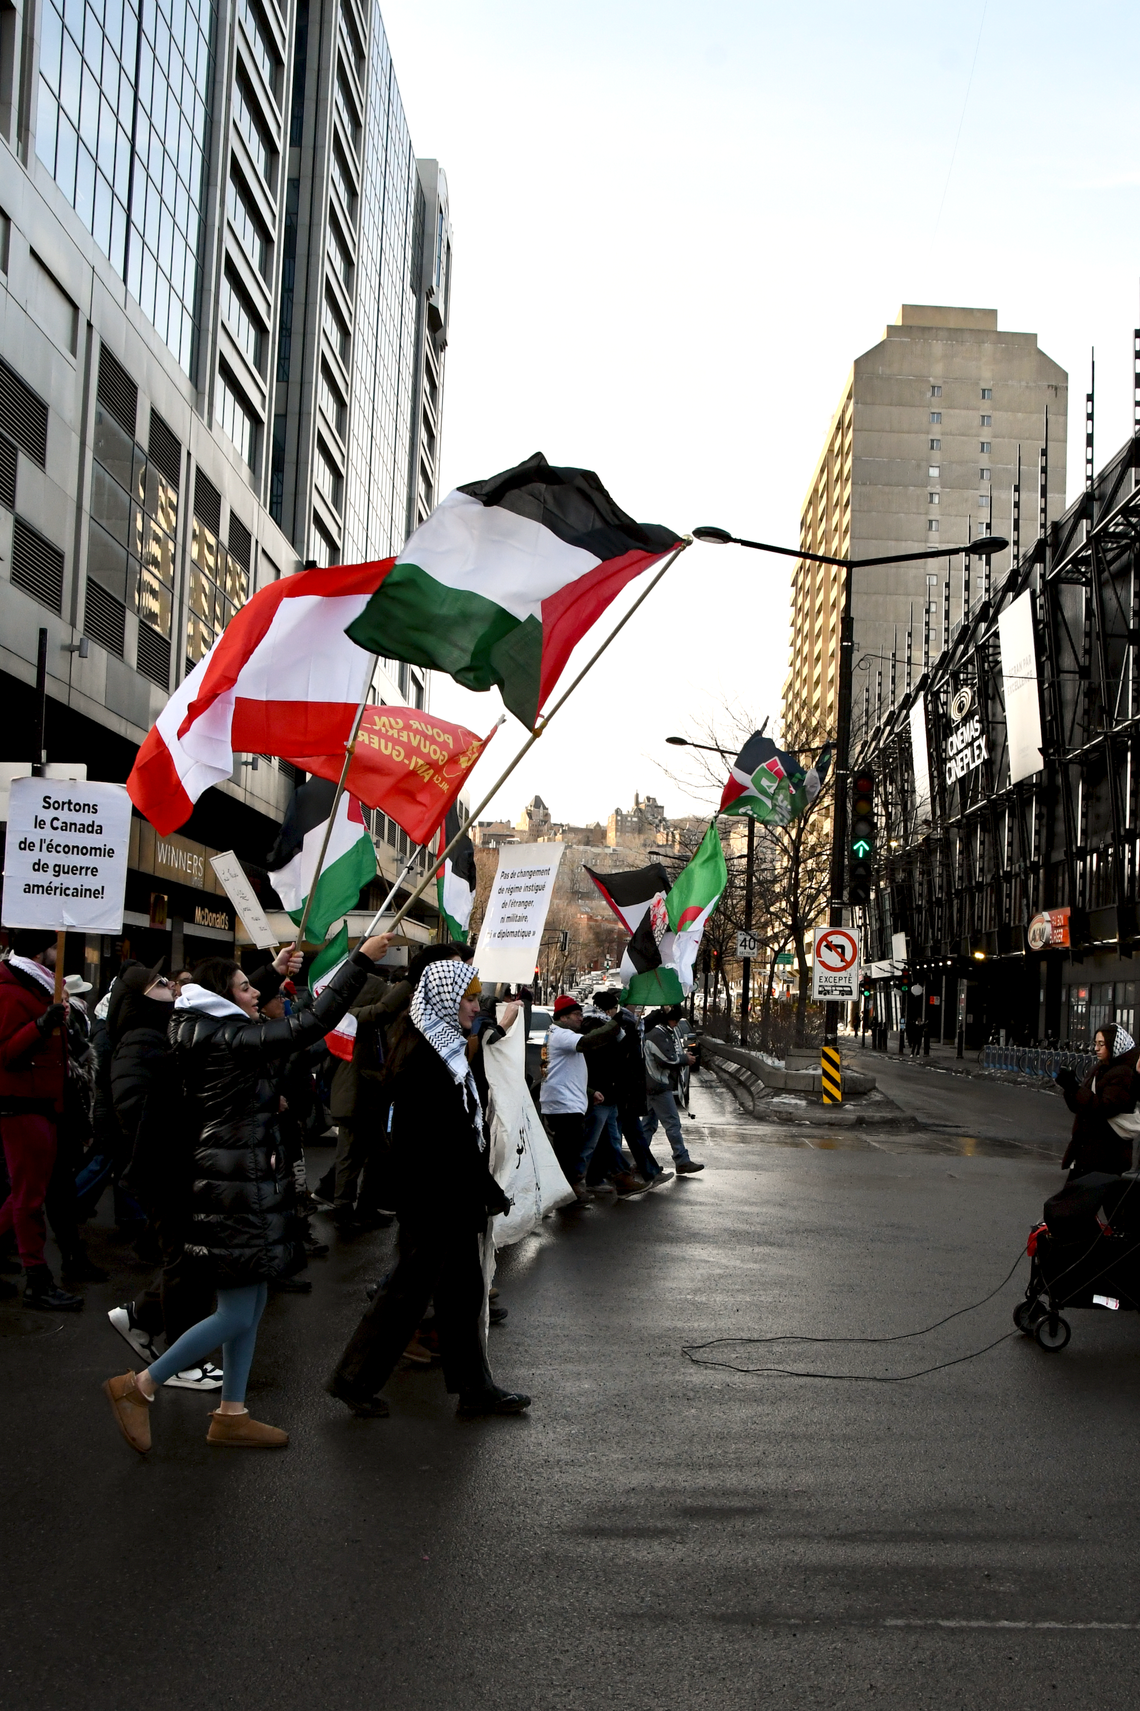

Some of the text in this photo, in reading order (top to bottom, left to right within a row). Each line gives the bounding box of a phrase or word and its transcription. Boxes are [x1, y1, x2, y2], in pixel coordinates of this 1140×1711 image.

[948, 715, 980, 757] CINÉMAS
[946, 735, 990, 785] CINEPLEX
[42, 795, 98, 814] Sortons
[34, 815, 103, 835] le Canada
[18, 837, 115, 858] de l'économie
[32, 858, 98, 878] de guerre
[157, 841, 204, 877] WINNERS
[500, 867, 550, 880] Pas de changement
[23, 881, 105, 899] américaine!
[498, 881, 547, 896] de régime instigué
[501, 900, 509, 909] de
[500, 914, 506, 923] ni
[497, 929, 531, 941] diplomatique
[740, 937, 755, 951] 40
[819, 974, 853, 984] EXCEPTÉ
[293, 1148, 307, 1193] RONX
